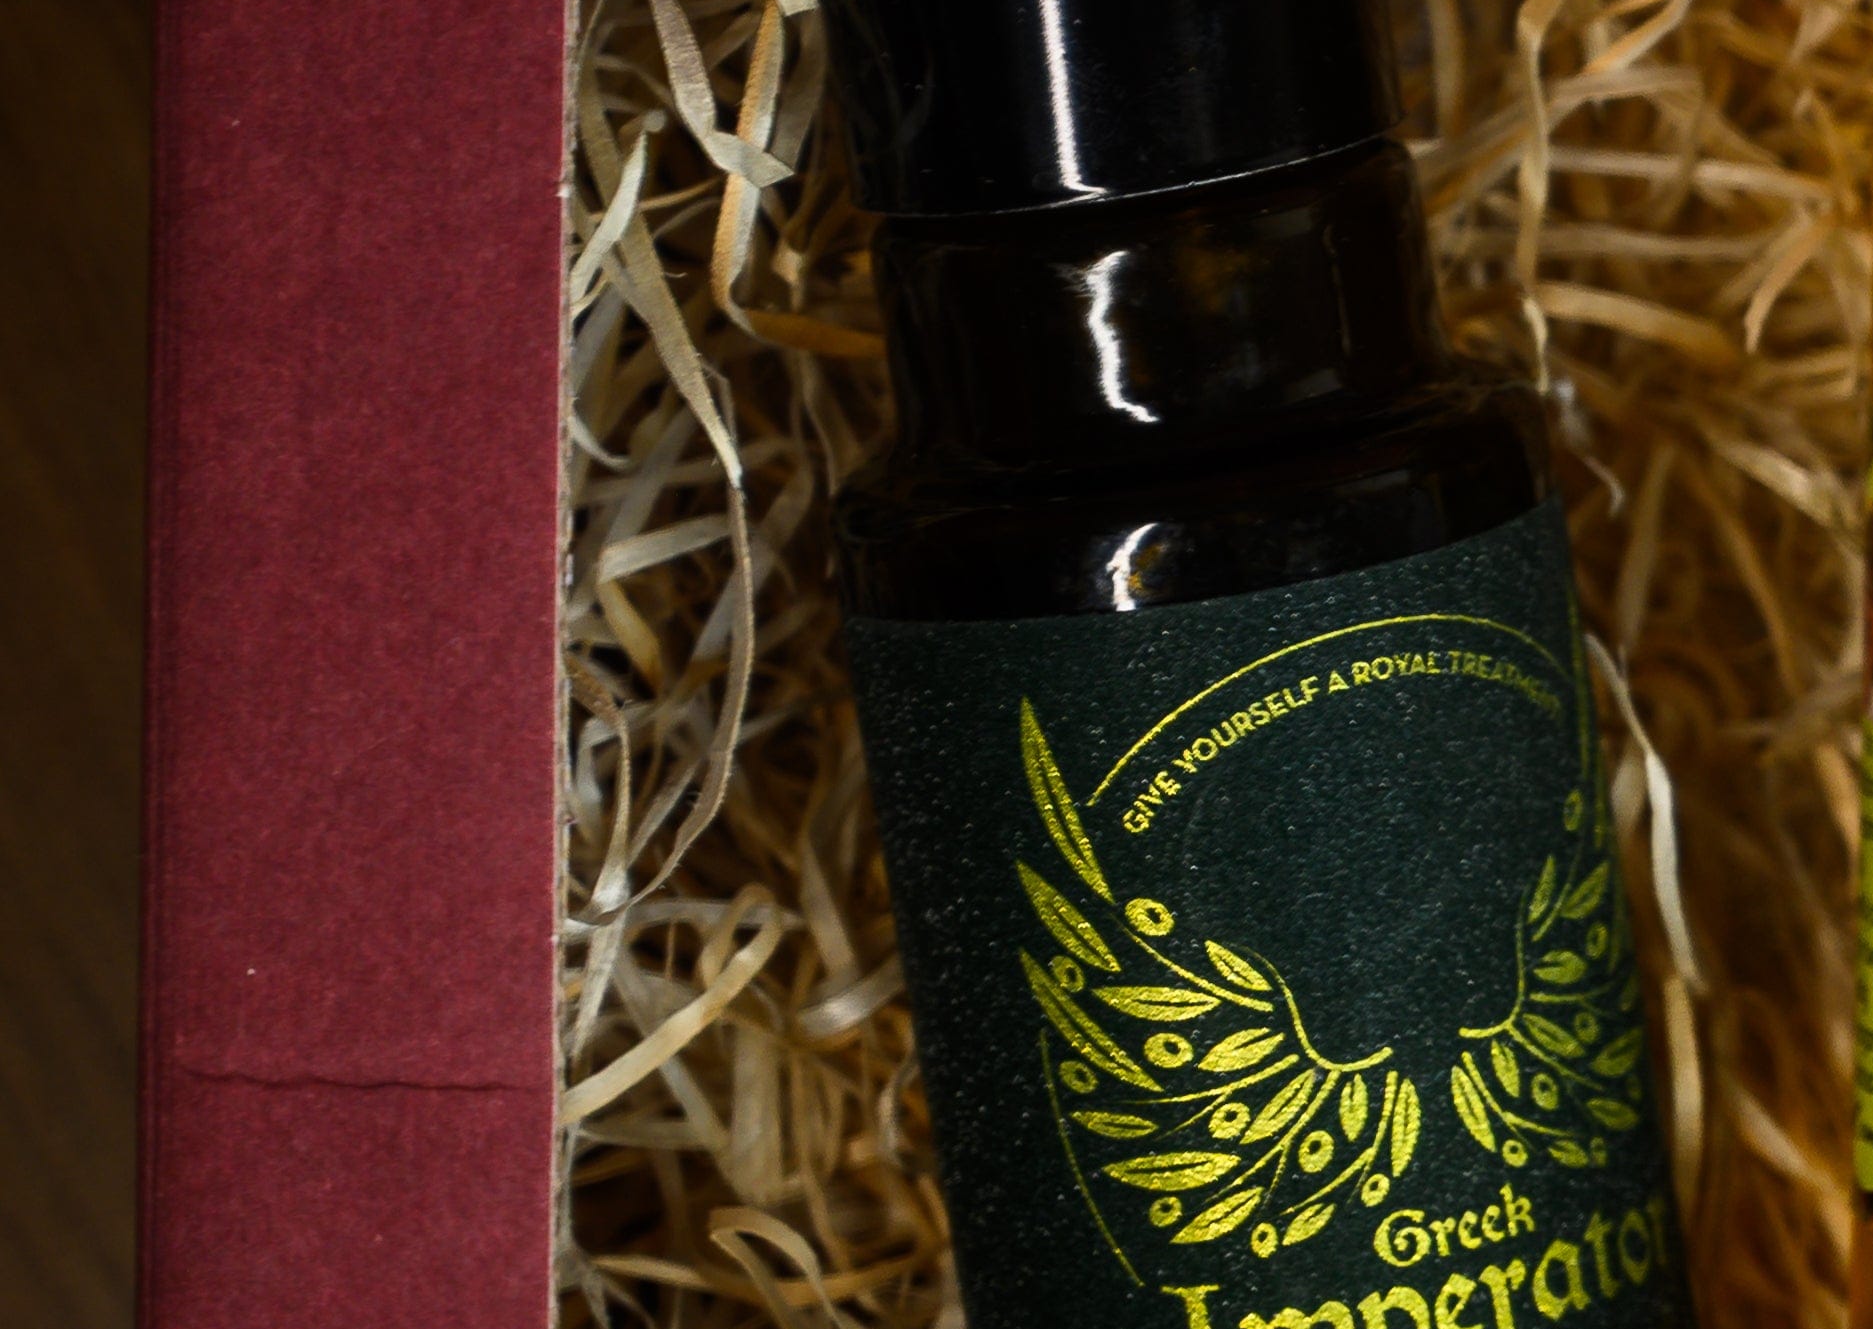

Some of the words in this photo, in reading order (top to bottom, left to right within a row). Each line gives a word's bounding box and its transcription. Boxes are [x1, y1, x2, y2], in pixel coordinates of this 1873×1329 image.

[1121, 769, 1183, 835] GIVE
[1173, 676, 1321, 774] YOURSELF
[1327, 670, 1350, 695] A
[1351, 649, 1441, 686] ROYAL
[1373, 1182, 1537, 1268] Greek
